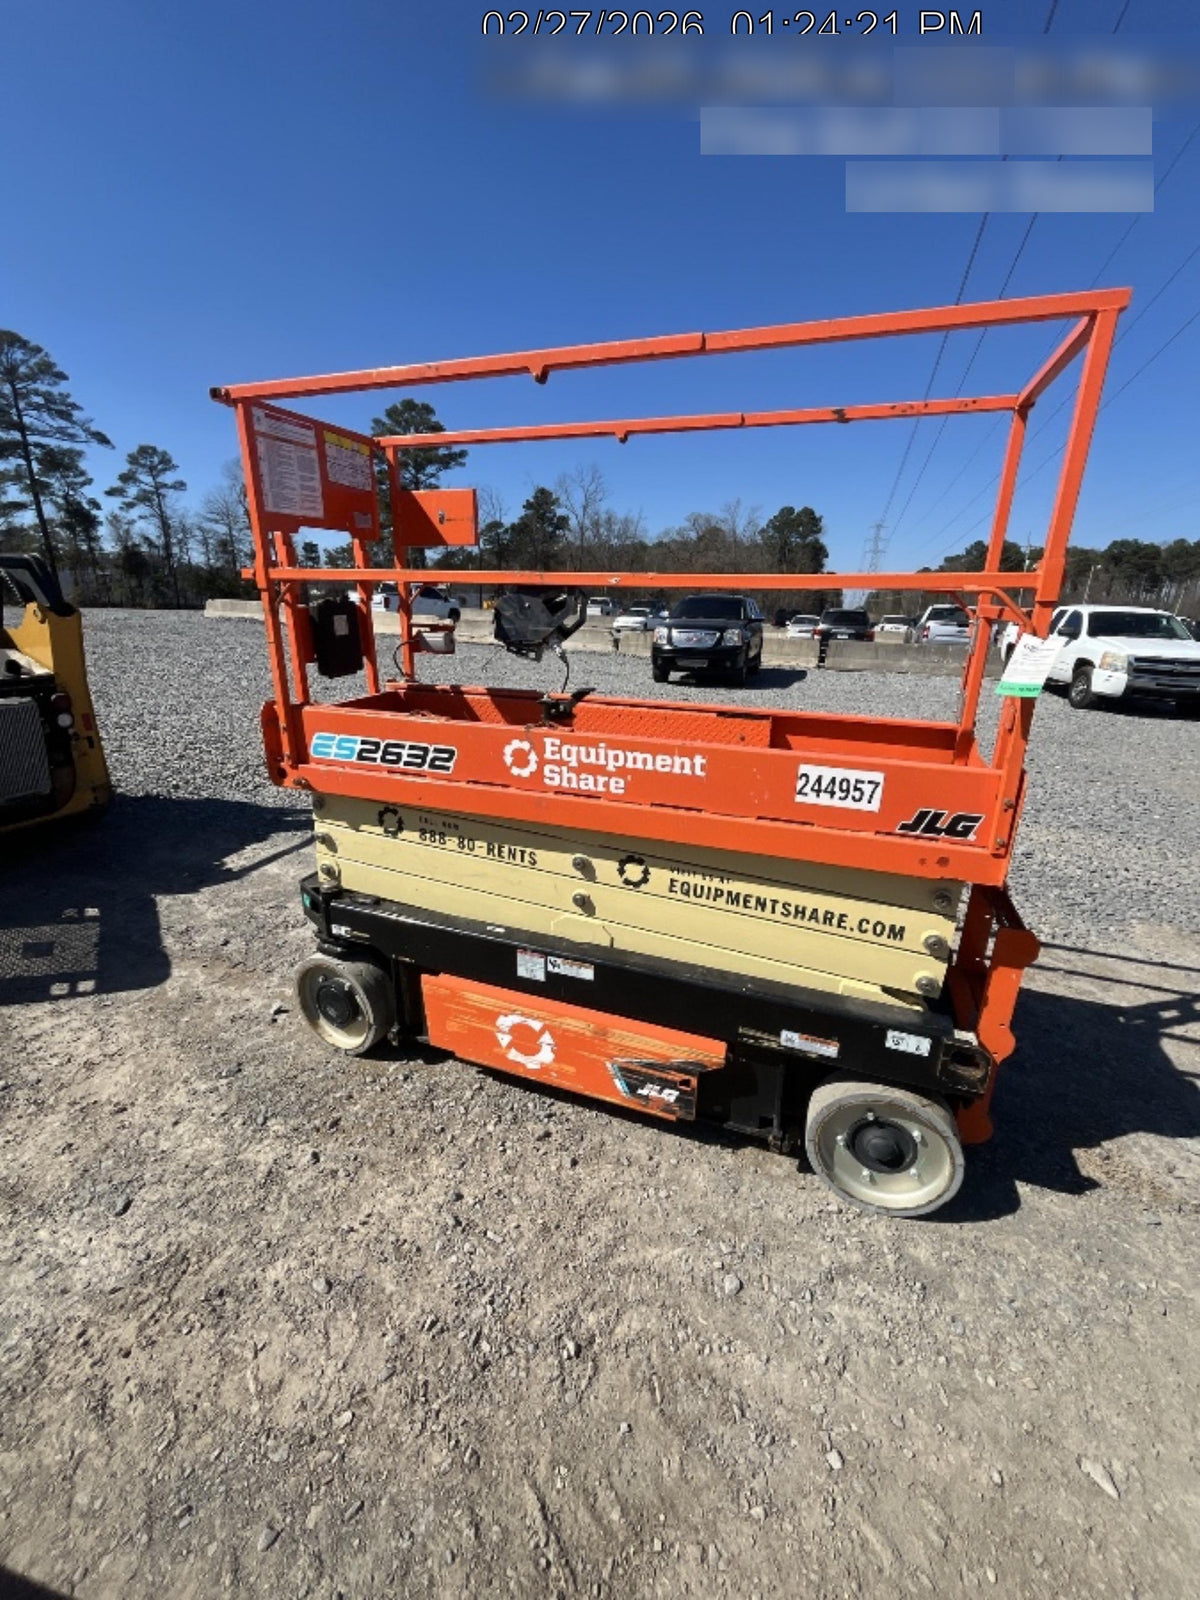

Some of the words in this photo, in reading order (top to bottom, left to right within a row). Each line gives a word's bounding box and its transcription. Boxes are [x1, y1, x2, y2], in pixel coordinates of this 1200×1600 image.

[310, 732, 457, 774] ES2632
[543, 737, 706, 777] Equipment
[543, 764, 625, 794] Share
[797, 773, 880, 804] 244957
[897, 808, 985, 840] JLG
[419, 828, 538, 866] 888-80-RENTS
[668, 878, 906, 942] EQUIPMENTSHARE.COM
